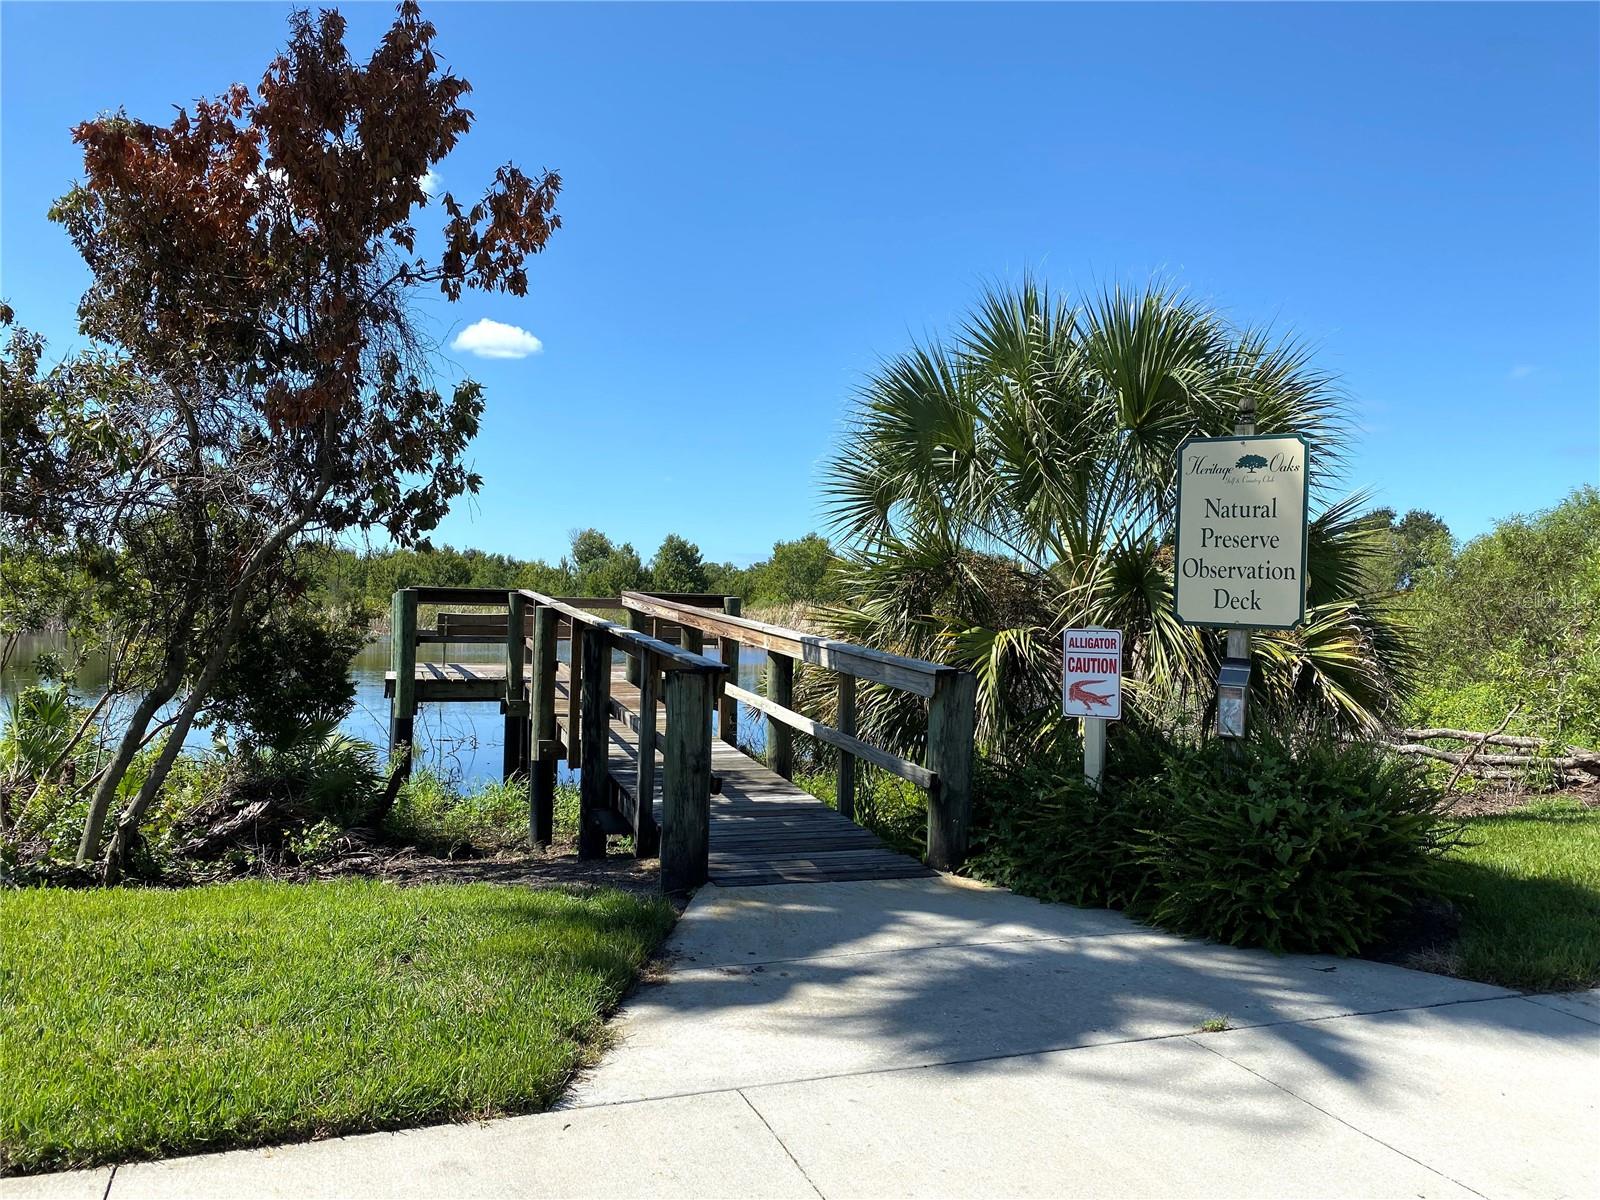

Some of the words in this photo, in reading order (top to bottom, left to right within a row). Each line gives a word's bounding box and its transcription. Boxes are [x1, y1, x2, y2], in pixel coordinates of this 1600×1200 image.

[1185, 455, 1234, 480] Heritage
[1269, 451, 1301, 473] Oaks
[1204, 497, 1278, 519] Natural
[1200, 527, 1280, 549] Preserve
[1182, 557, 1297, 581] Observation
[1213, 588, 1262, 611] Deck
[1068, 637, 1117, 649] ALLIGATOR
[1067, 657, 1117, 674] CAUTION
